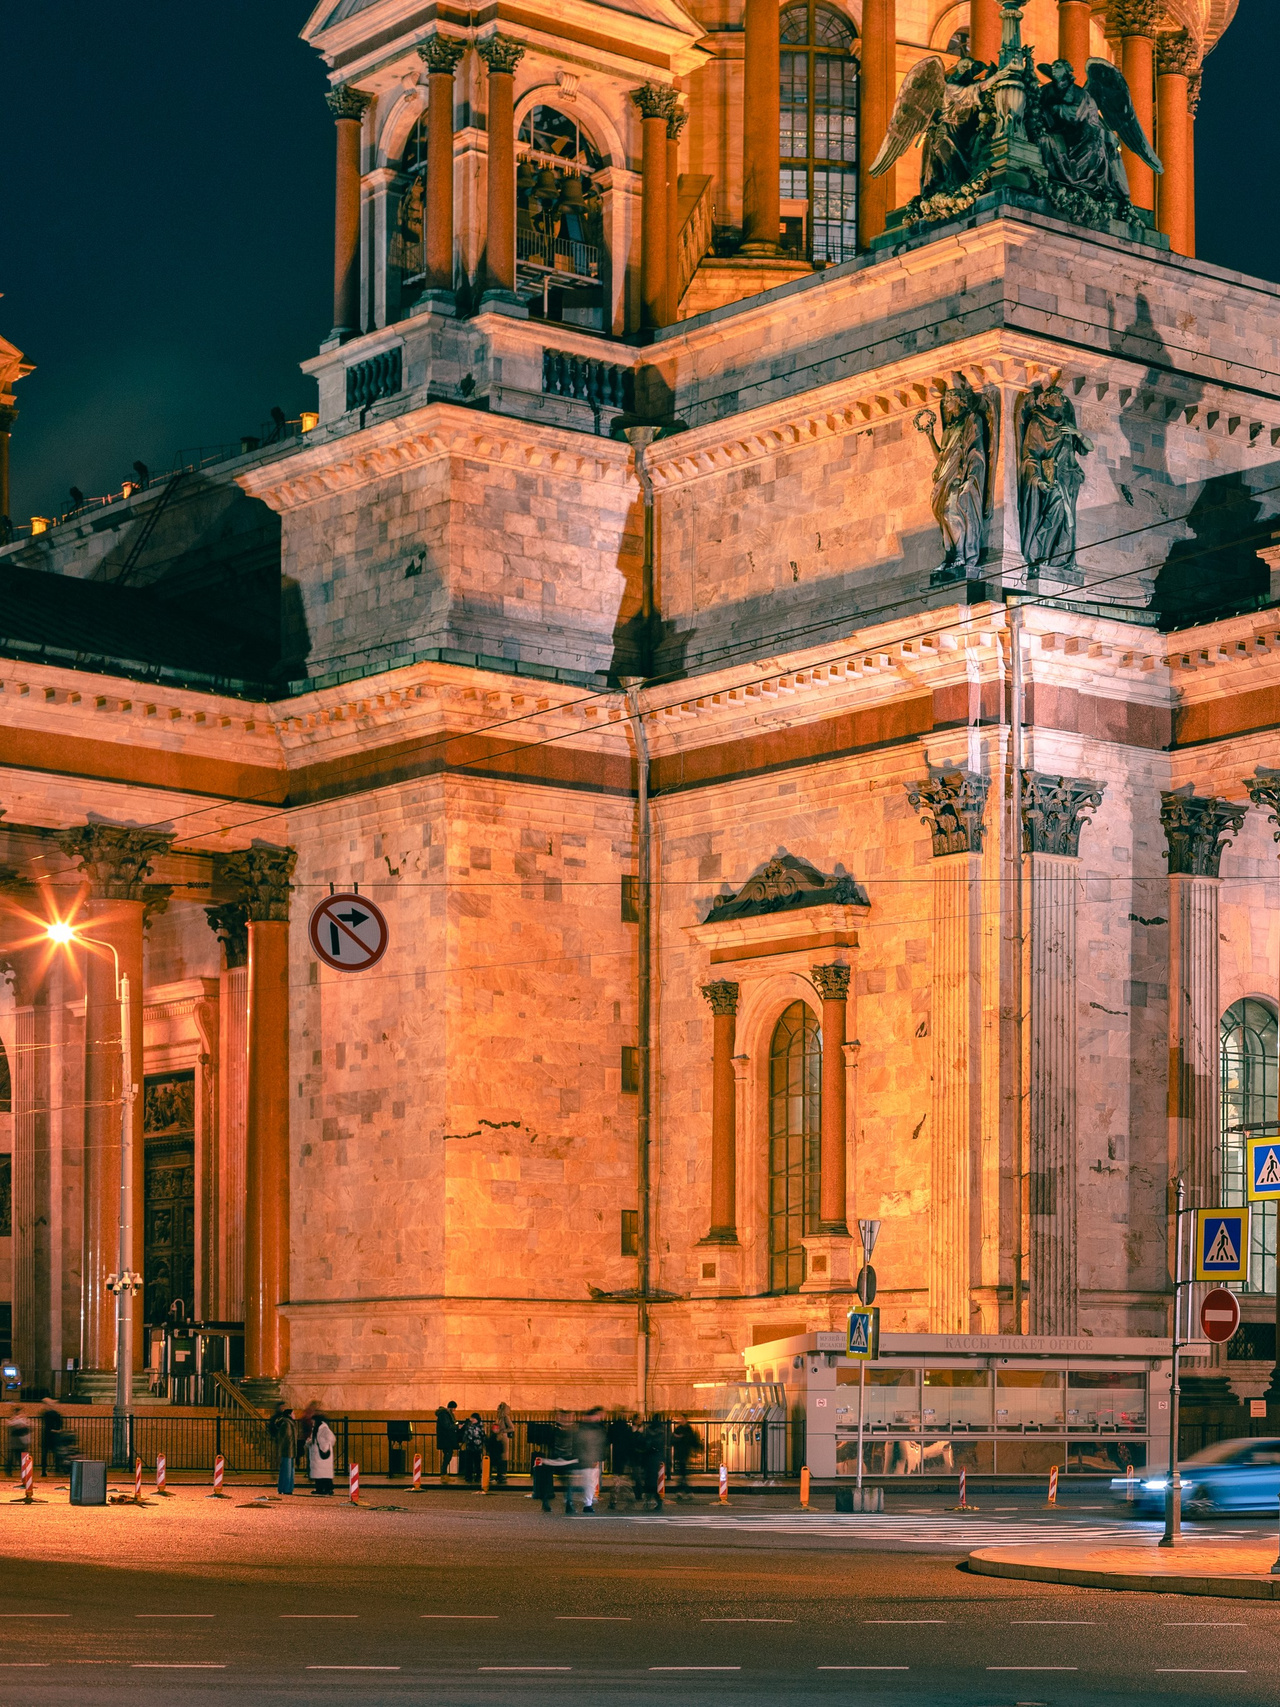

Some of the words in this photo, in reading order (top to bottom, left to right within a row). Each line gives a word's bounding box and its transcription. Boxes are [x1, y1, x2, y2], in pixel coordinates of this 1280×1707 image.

[945, 1338, 990, 1349] КАССЫ
[1000, 1338, 1045, 1350] TICKET
[1050, 1339, 1093, 1351] OFFICE
